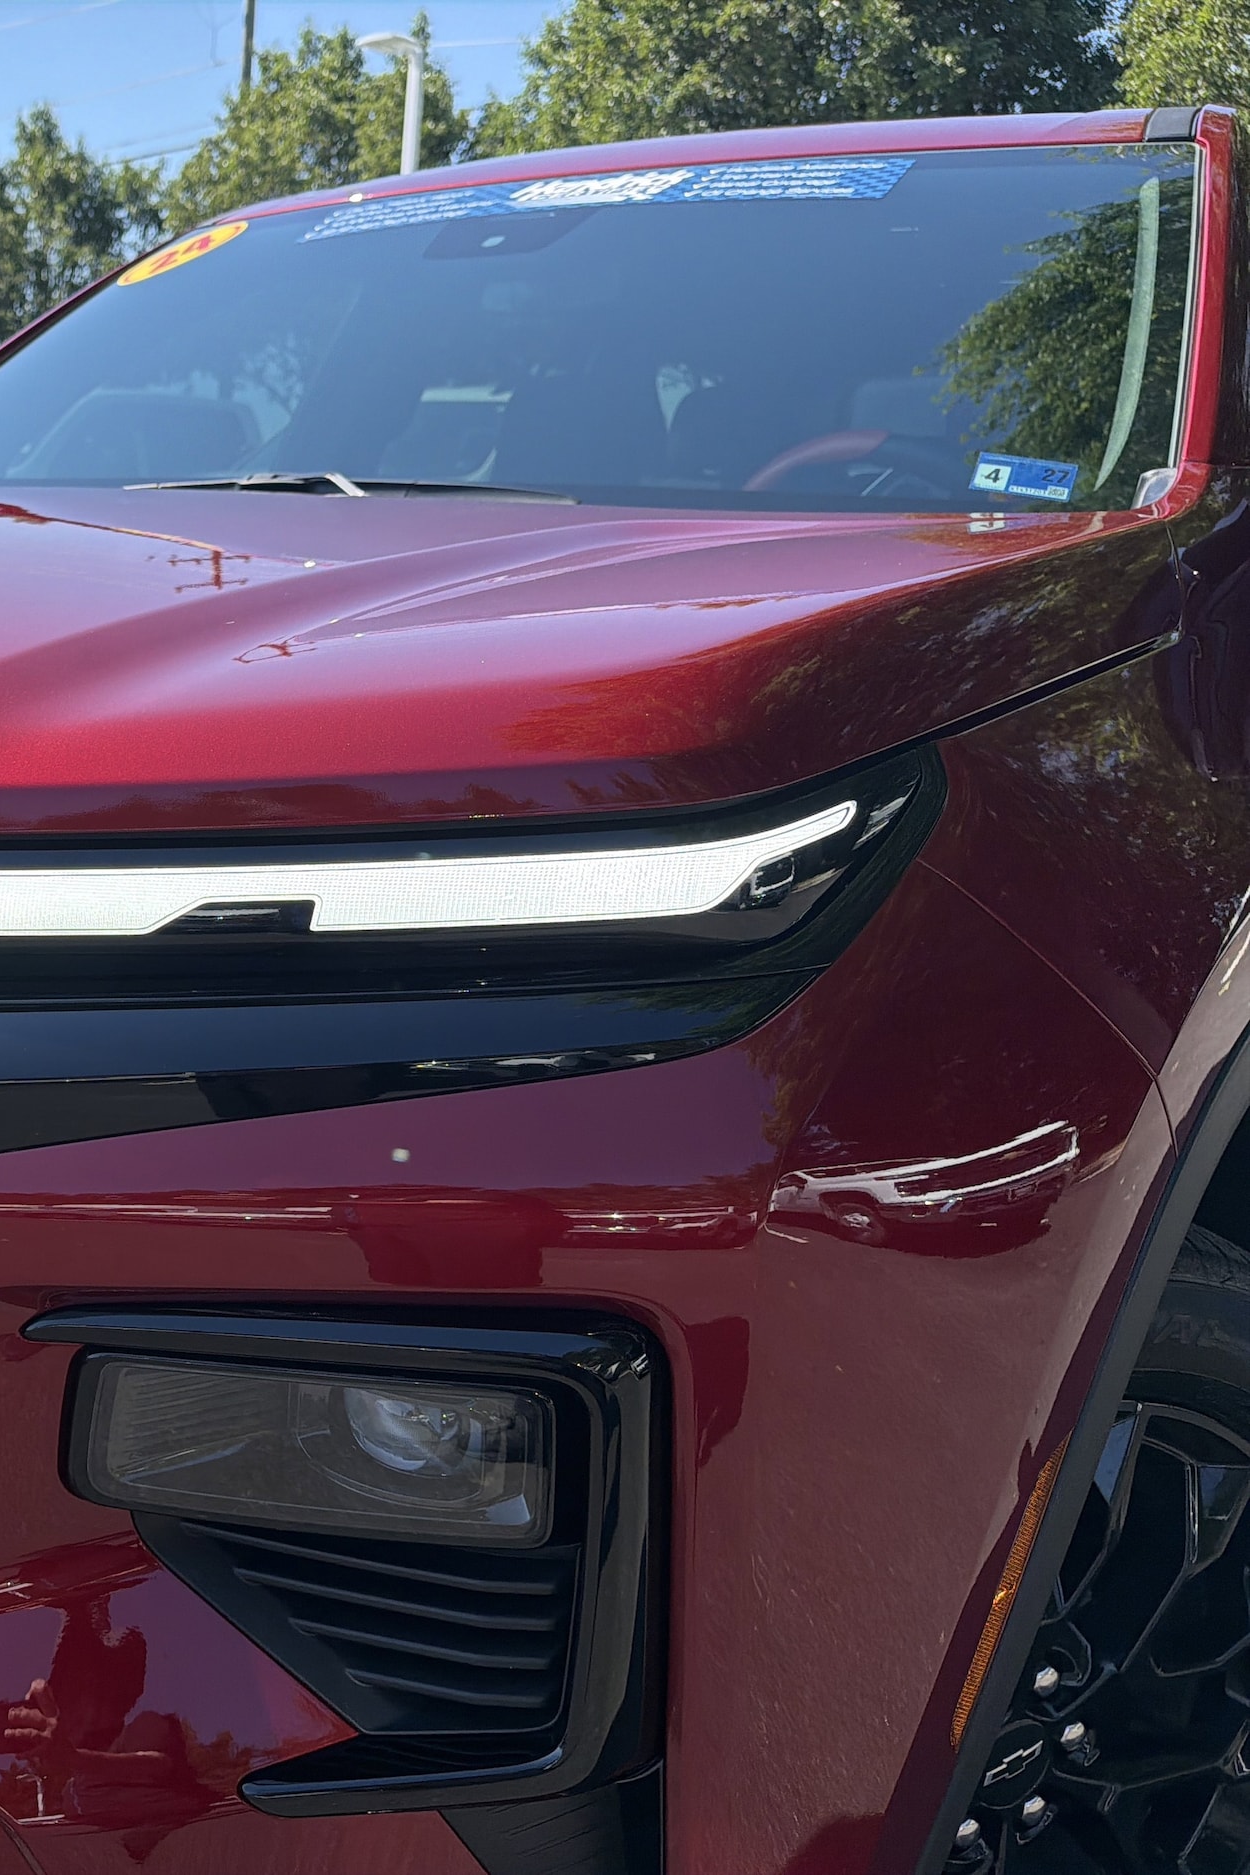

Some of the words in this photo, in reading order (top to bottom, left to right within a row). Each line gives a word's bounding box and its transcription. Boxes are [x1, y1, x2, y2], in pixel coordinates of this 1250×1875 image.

[148, 235, 214, 275] 24
[983, 468, 1001, 484] 4
[1041, 469, 1071, 484] 27
